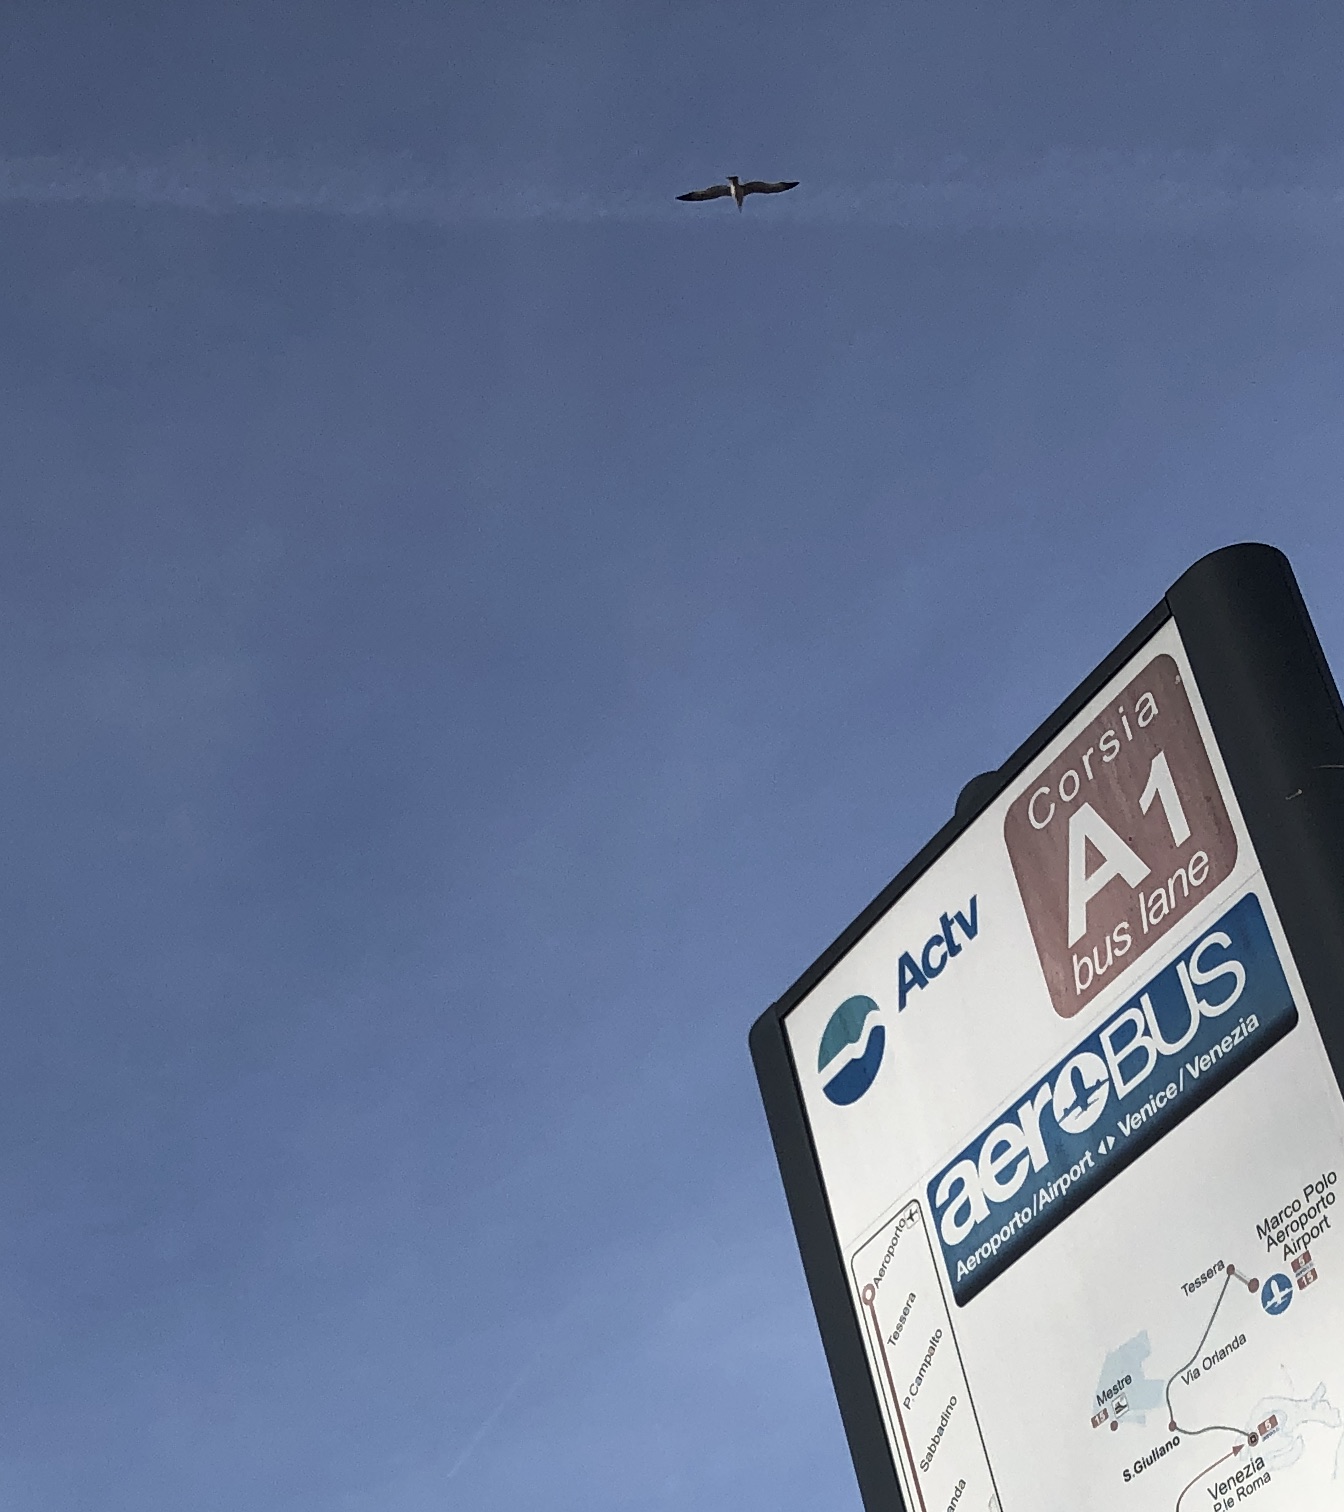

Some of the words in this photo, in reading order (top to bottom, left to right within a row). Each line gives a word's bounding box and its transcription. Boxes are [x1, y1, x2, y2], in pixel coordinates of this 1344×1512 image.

[1028, 691, 1158, 829] Corsia
[1068, 751, 1191, 948] A1
[1072, 920, 1133, 995] bus
[1139, 850, 1210, 934] lane
[897, 894, 979, 1012] Actv
[1256, 1199, 1302, 1240] Marco
[1303, 1171, 1337, 1203] Polo
[1266, 1192, 1336, 1252] Aeroporto
[873, 1217, 907, 1289] Aeroporto
[1283, 1215, 1331, 1261] Airport
[1181, 1260, 1225, 1297] Tessera
[1301, 1271, 1314, 1287] 15
[887, 1292, 917, 1346] Tessera
[903, 1328, 944, 1410] P.Campalto
[1181, 1368, 1201, 1386] Via
[1202, 1333, 1247, 1370] Orlanda
[1096, 1374, 1133, 1406] Mestre
[920, 1395, 958, 1473] Sabbadino
[1094, 1411, 1107, 1425] 15
[1122, 1435, 1181, 1482] S.Giuliano
[1207, 1456, 1265, 1500] Venezia
[1236, 1471, 1271, 1502] Roma
